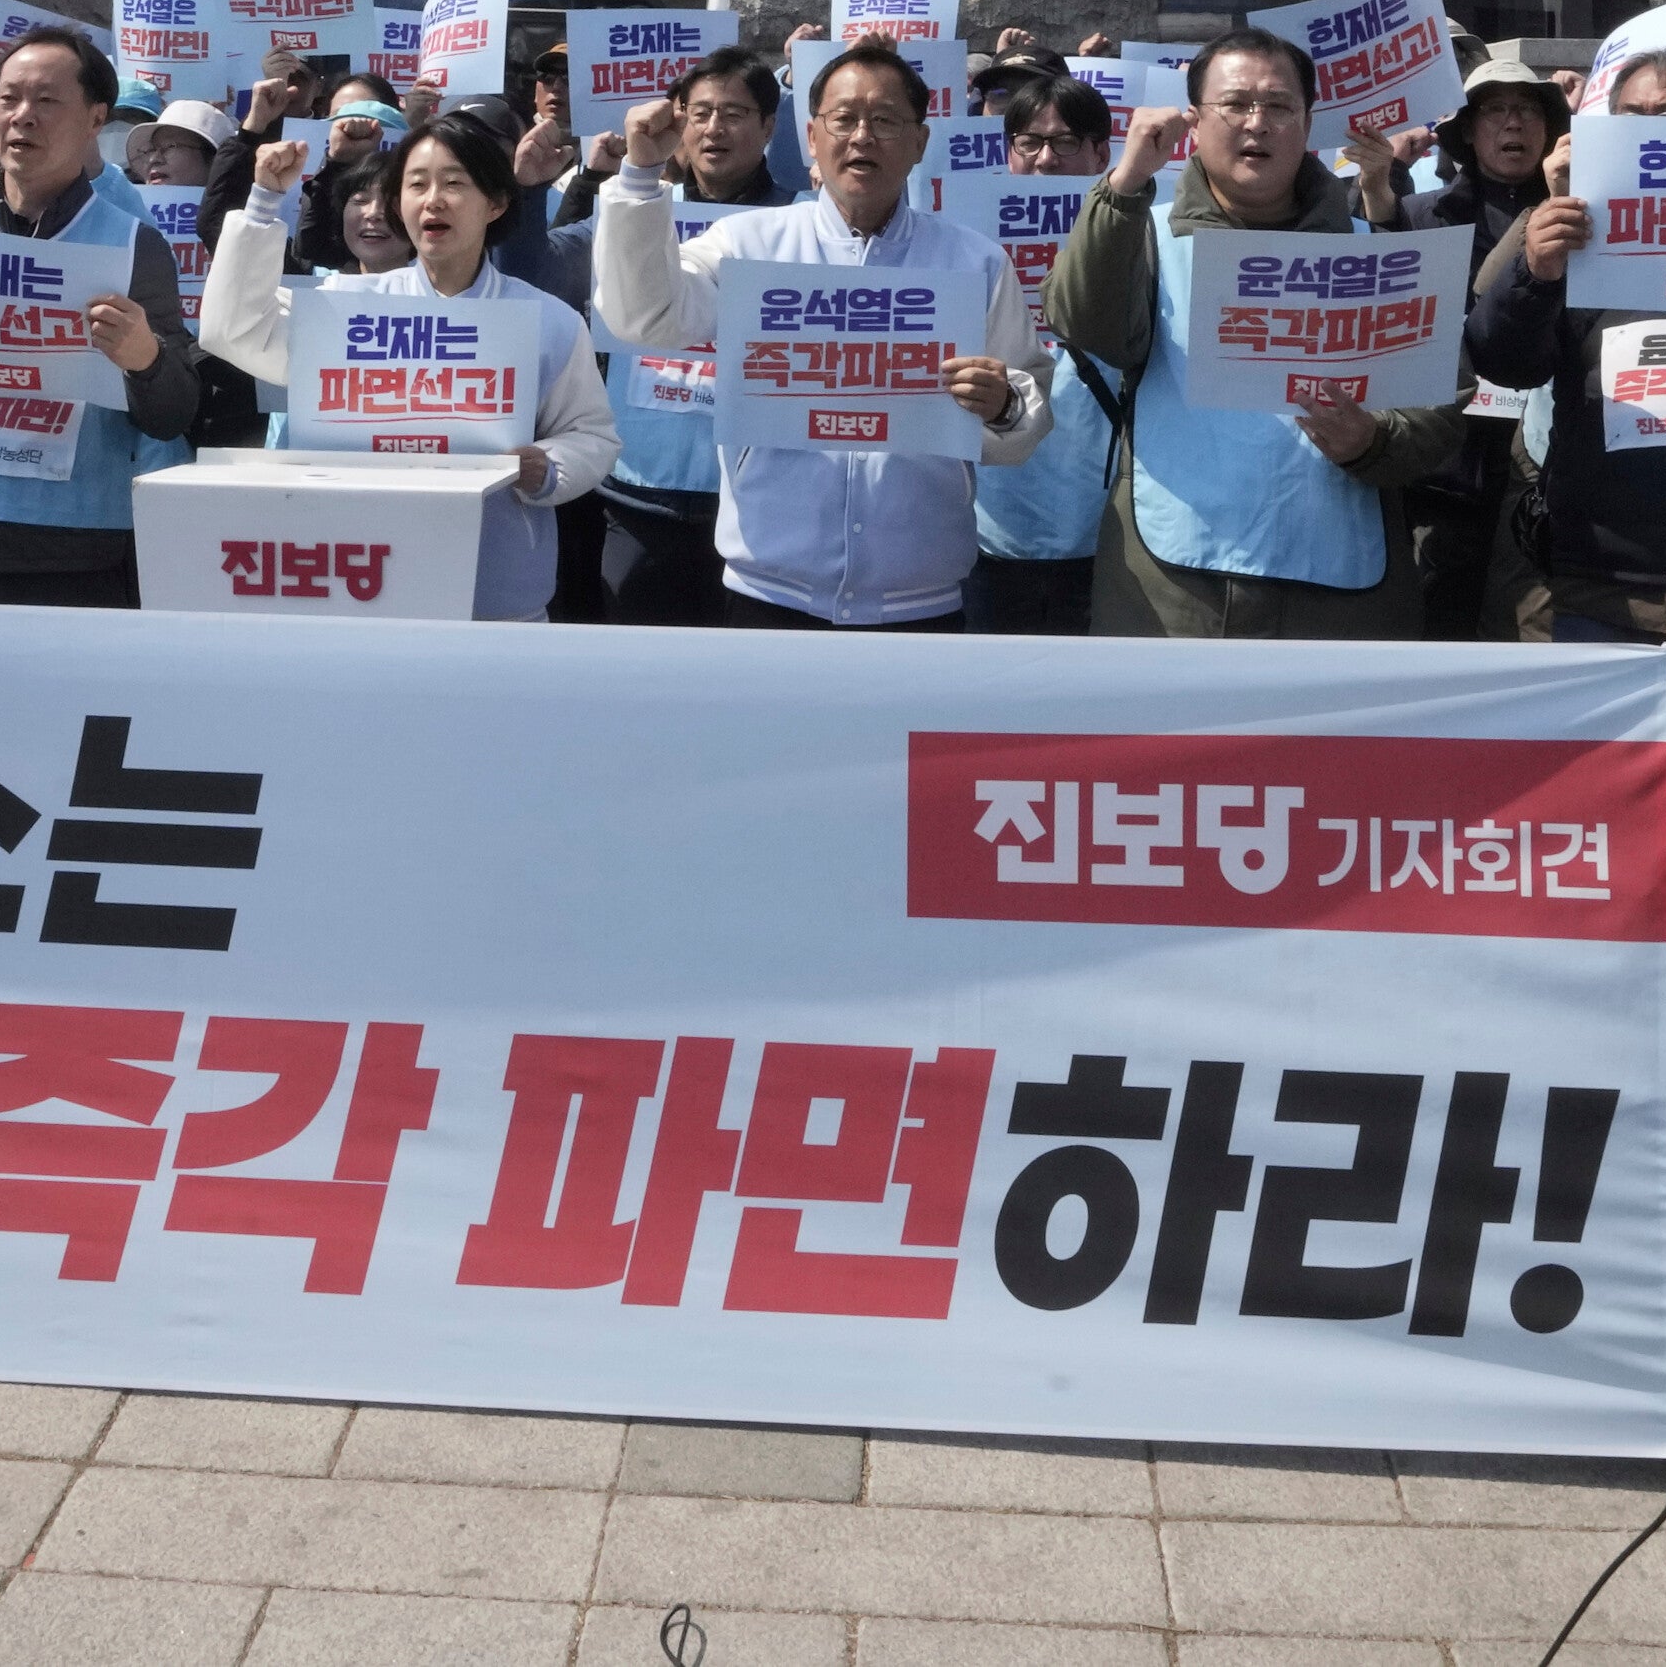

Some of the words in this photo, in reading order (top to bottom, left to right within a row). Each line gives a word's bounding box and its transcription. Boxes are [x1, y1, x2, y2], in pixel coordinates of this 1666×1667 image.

[119, 26, 210, 60] 즉각파면!
[608, 22, 701, 58] 헌재는
[1237, 249, 1422, 300] 윤석열은
[760, 287, 936, 332] 윤석열은
[1218, 294, 1437, 355] 즉각파면!
[346, 314, 479, 361] 헌재는
[318, 366, 516, 414] 파면선고!
[652, 385, 693, 403] 진보당
[815, 413, 880, 438] 진보당
[220, 540, 391, 601] 진보당
[973, 777, 1305, 895] 진보당
[1316, 815, 1613, 901] 기자회견
[455, 1031, 1621, 1339] 파면하라!
